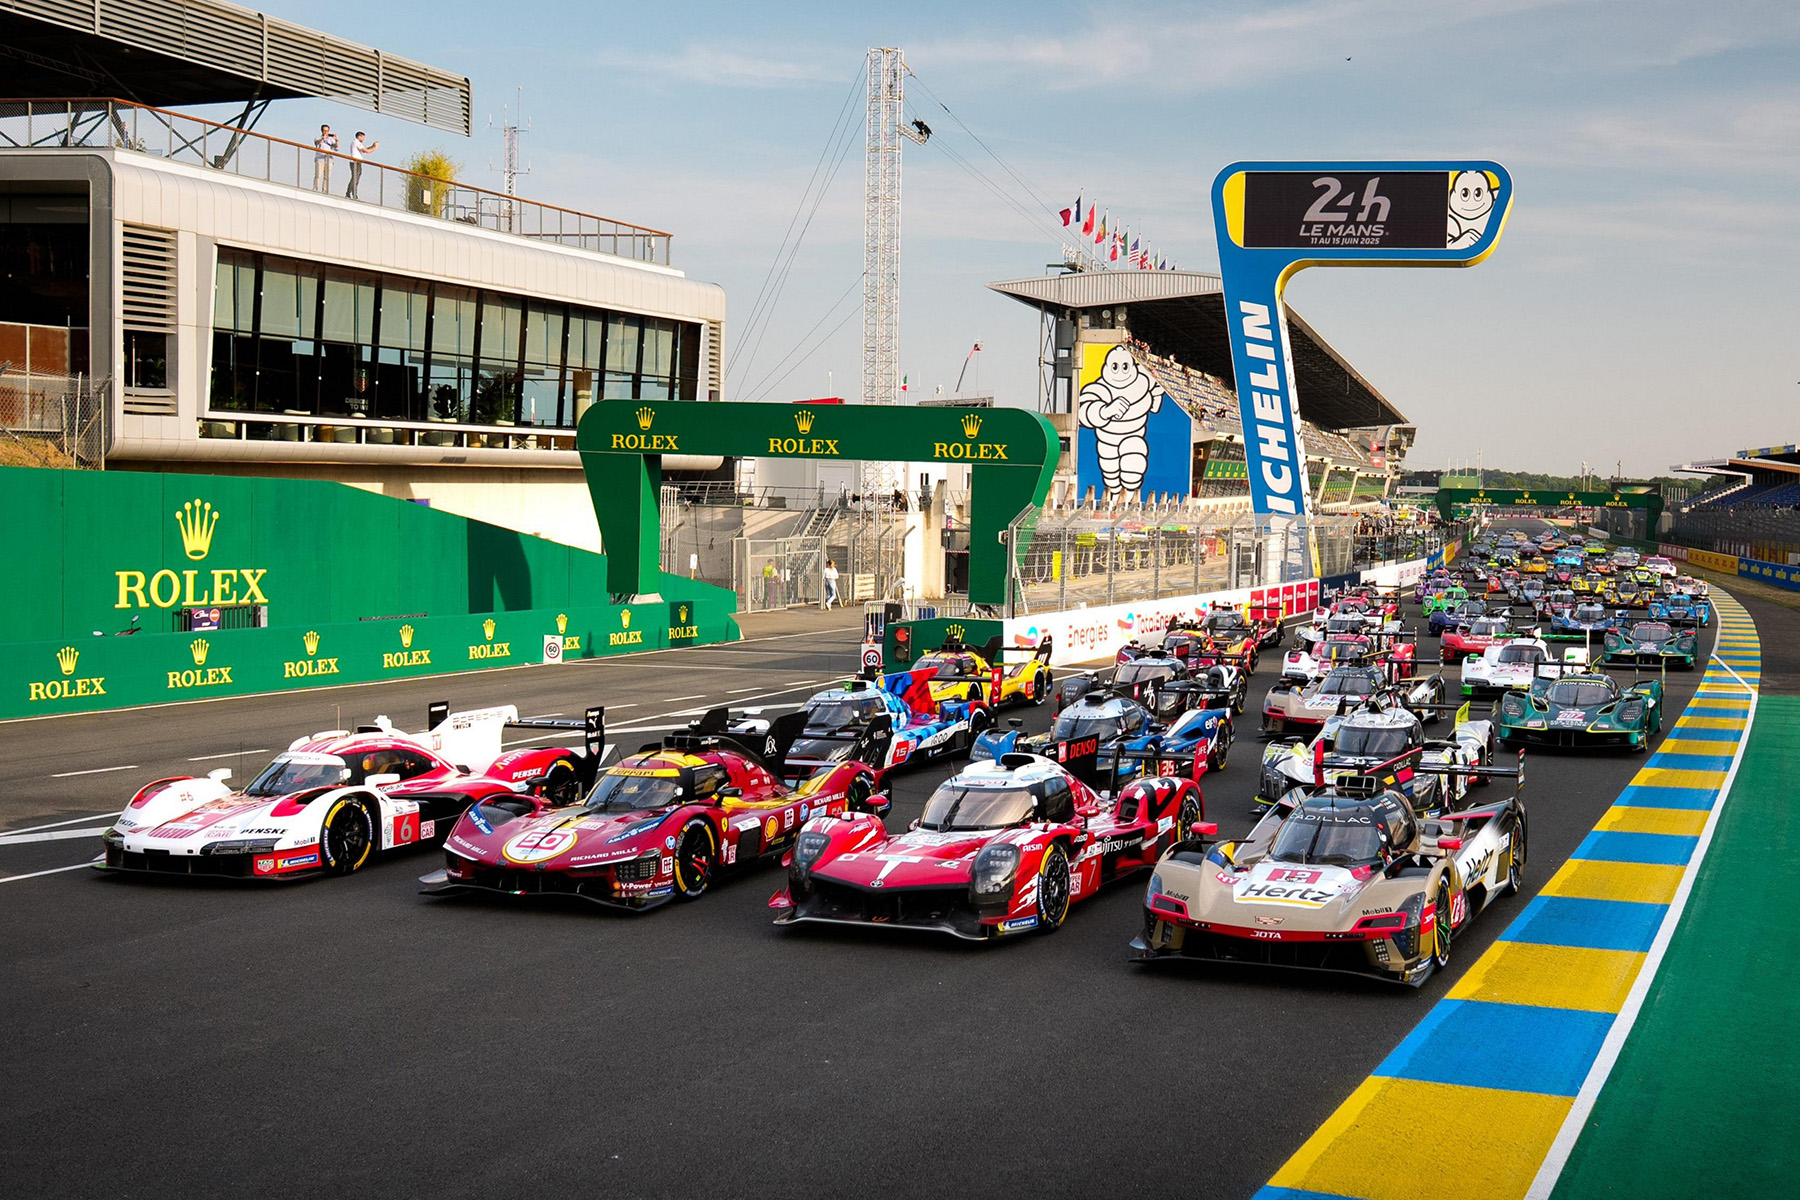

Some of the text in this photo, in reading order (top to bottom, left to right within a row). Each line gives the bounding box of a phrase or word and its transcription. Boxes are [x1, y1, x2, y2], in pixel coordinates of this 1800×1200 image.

[1303, 176, 1391, 222] 24h
[1300, 224, 1384, 236] LE MANS
[611, 434, 679, 450] ROLEX
[768, 438, 840, 455] ROLEX
[933, 442, 1008, 460] ROLEX
[114, 568, 268, 608] ROLEX
[609, 631, 642, 646] ROLEX
[668, 626, 698, 640] ROLEX
[468, 642, 511, 660] ROLEX
[382, 649, 432, 668] ROLEX
[866, 654, 878, 663] 60
[284, 658, 340, 678] ROLEX
[168, 666, 234, 689] ROLEX
[29, 677, 106, 700] ROLEX
[896, 747, 907, 757] 15
[1070, 739, 1097, 759] DENSO
[1197, 745, 1207, 755] JFE
[512, 768, 542, 780] PENSKE
[1289, 813, 1371, 824] CADILLAC
[400, 816, 412, 841] 6
[422, 828, 433, 837] CAR
[607, 822, 659, 843] ADLER GROUP
[520, 834, 564, 847] 50
[1022, 843, 1042, 852] AISIN
[570, 847, 638, 861] RICHARD MILLE
[1088, 860, 1097, 887] 7
[621, 881, 652, 889] V-Power
[1070, 882, 1080, 892] AR
[1165, 890, 1184, 900] Mobil
[1240, 884, 1334, 902] Hertz
[1010, 919, 1034, 927] MICHELIN
[1250, 930, 1282, 939] JOTA
